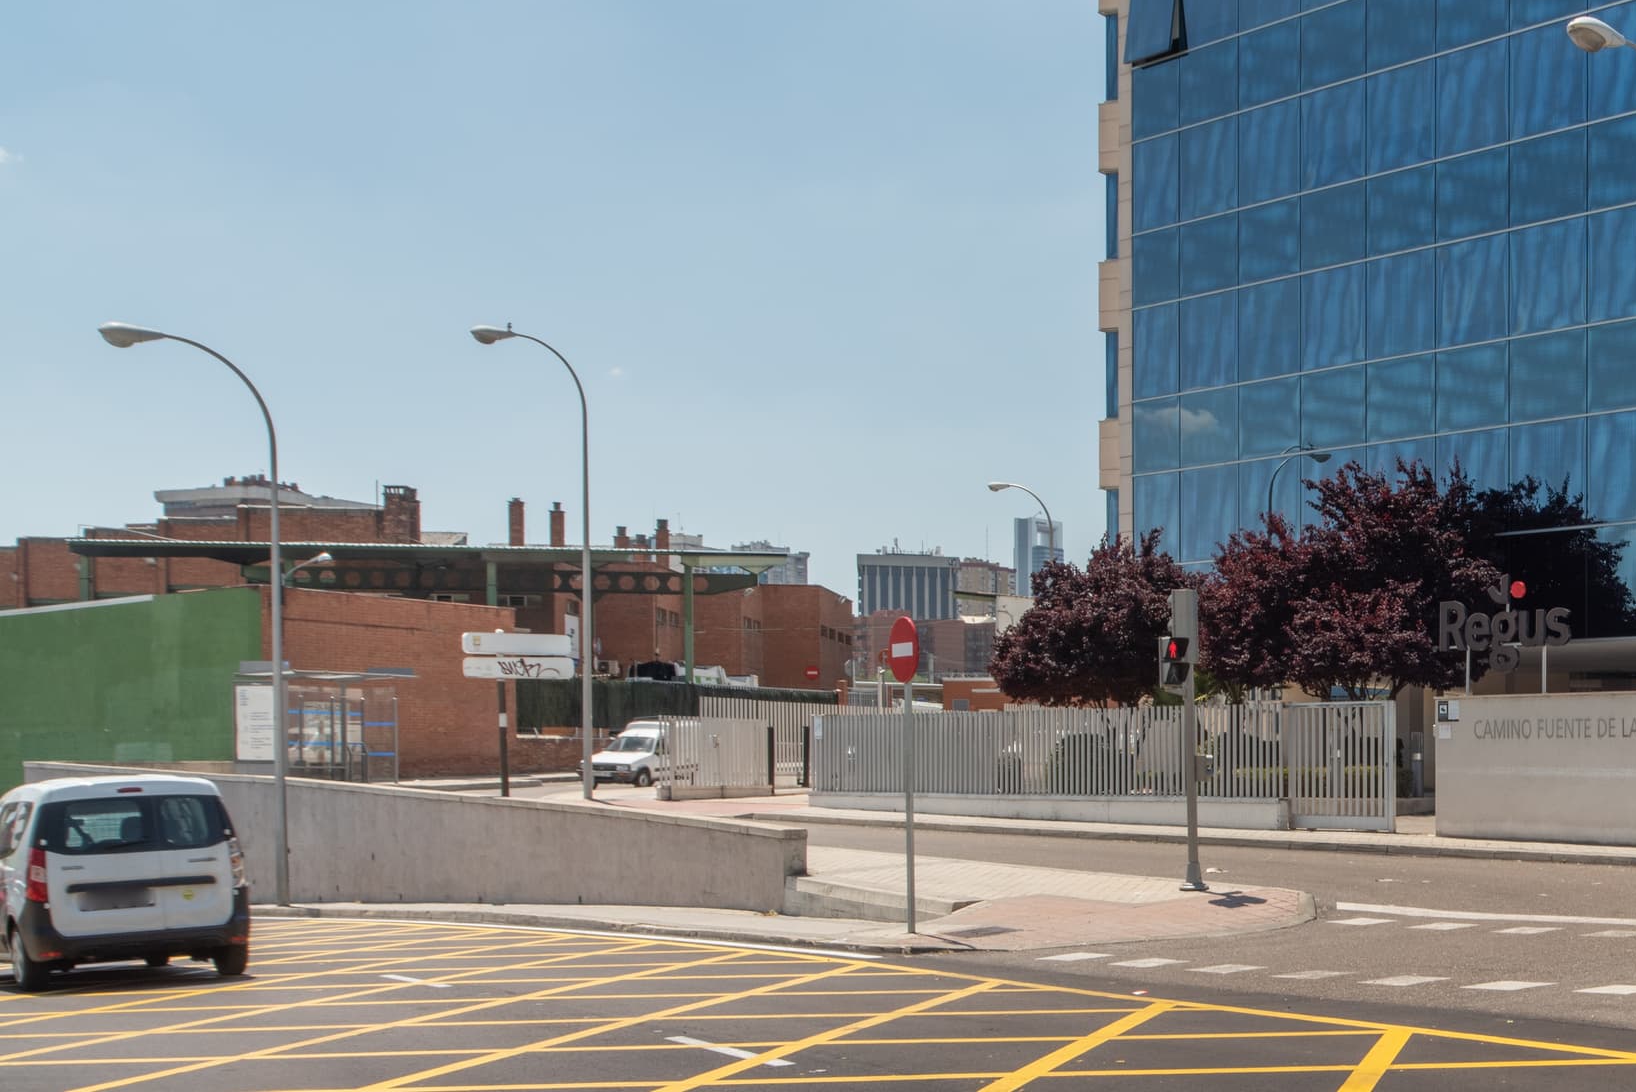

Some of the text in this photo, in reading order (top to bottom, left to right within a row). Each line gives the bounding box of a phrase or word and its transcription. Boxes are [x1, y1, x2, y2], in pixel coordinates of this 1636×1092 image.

[1438, 600, 1571, 673] Regus
[1473, 718, 1532, 740] CAMINO
[1536, 717, 1592, 739] FUENTE
[1597, 717, 1616, 739] DE
